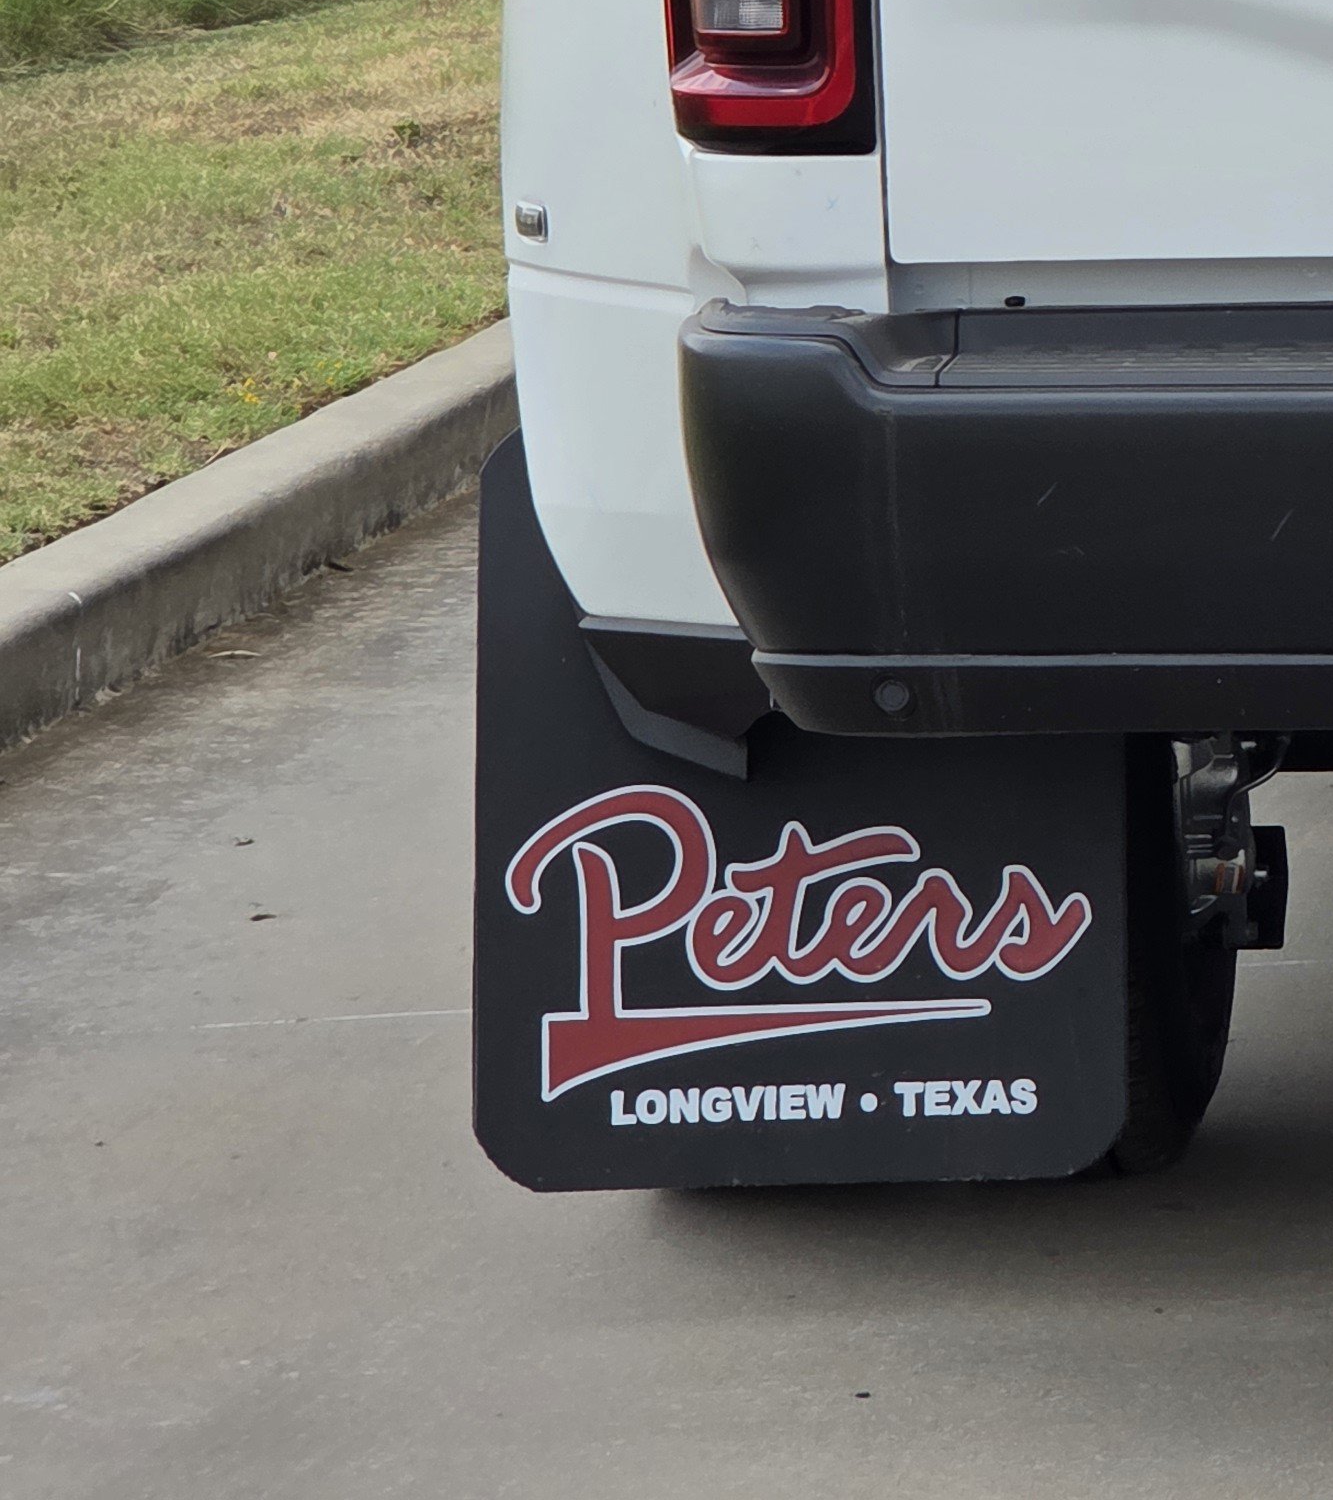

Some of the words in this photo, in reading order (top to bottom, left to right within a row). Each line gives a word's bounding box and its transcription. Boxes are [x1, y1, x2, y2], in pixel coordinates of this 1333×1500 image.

[505, 784, 1093, 1101] Peters
[610, 1083, 846, 1126] LONGVIEW
[893, 1079, 1038, 1117] TEXAS
